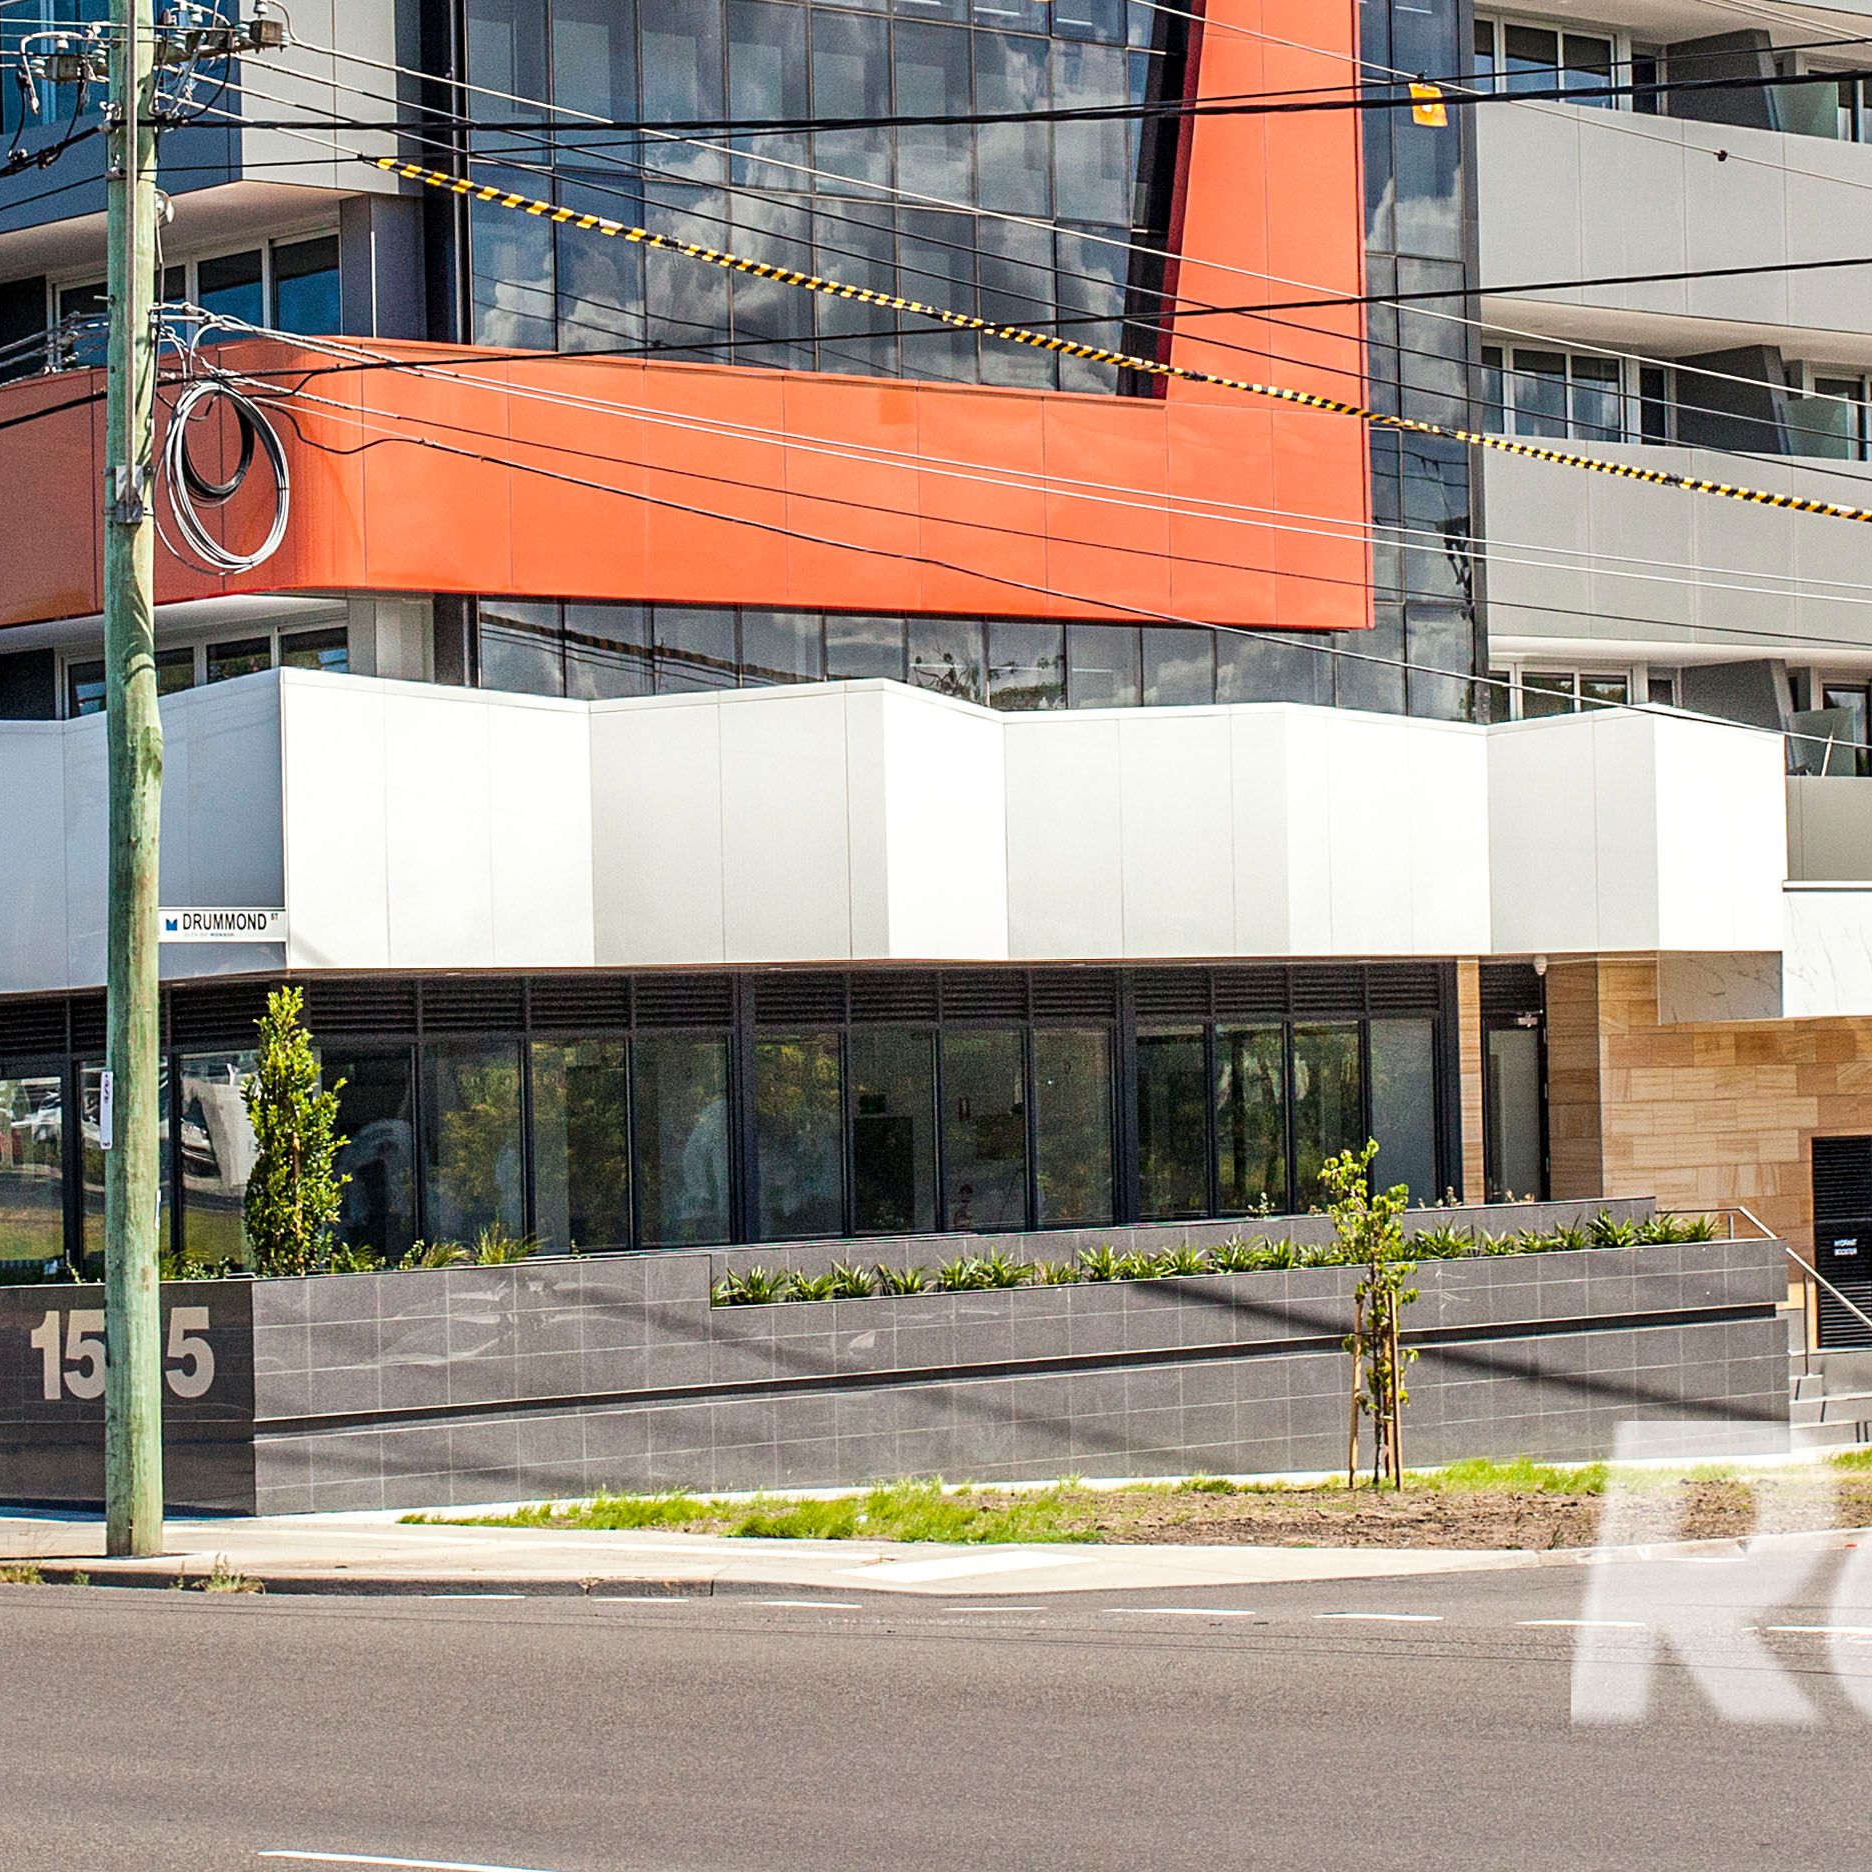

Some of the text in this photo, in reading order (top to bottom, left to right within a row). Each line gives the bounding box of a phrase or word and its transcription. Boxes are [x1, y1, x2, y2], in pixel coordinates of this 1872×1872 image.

[182, 912, 279, 931] DRUMMOND ST
[31, 1306, 216, 1401] 155
